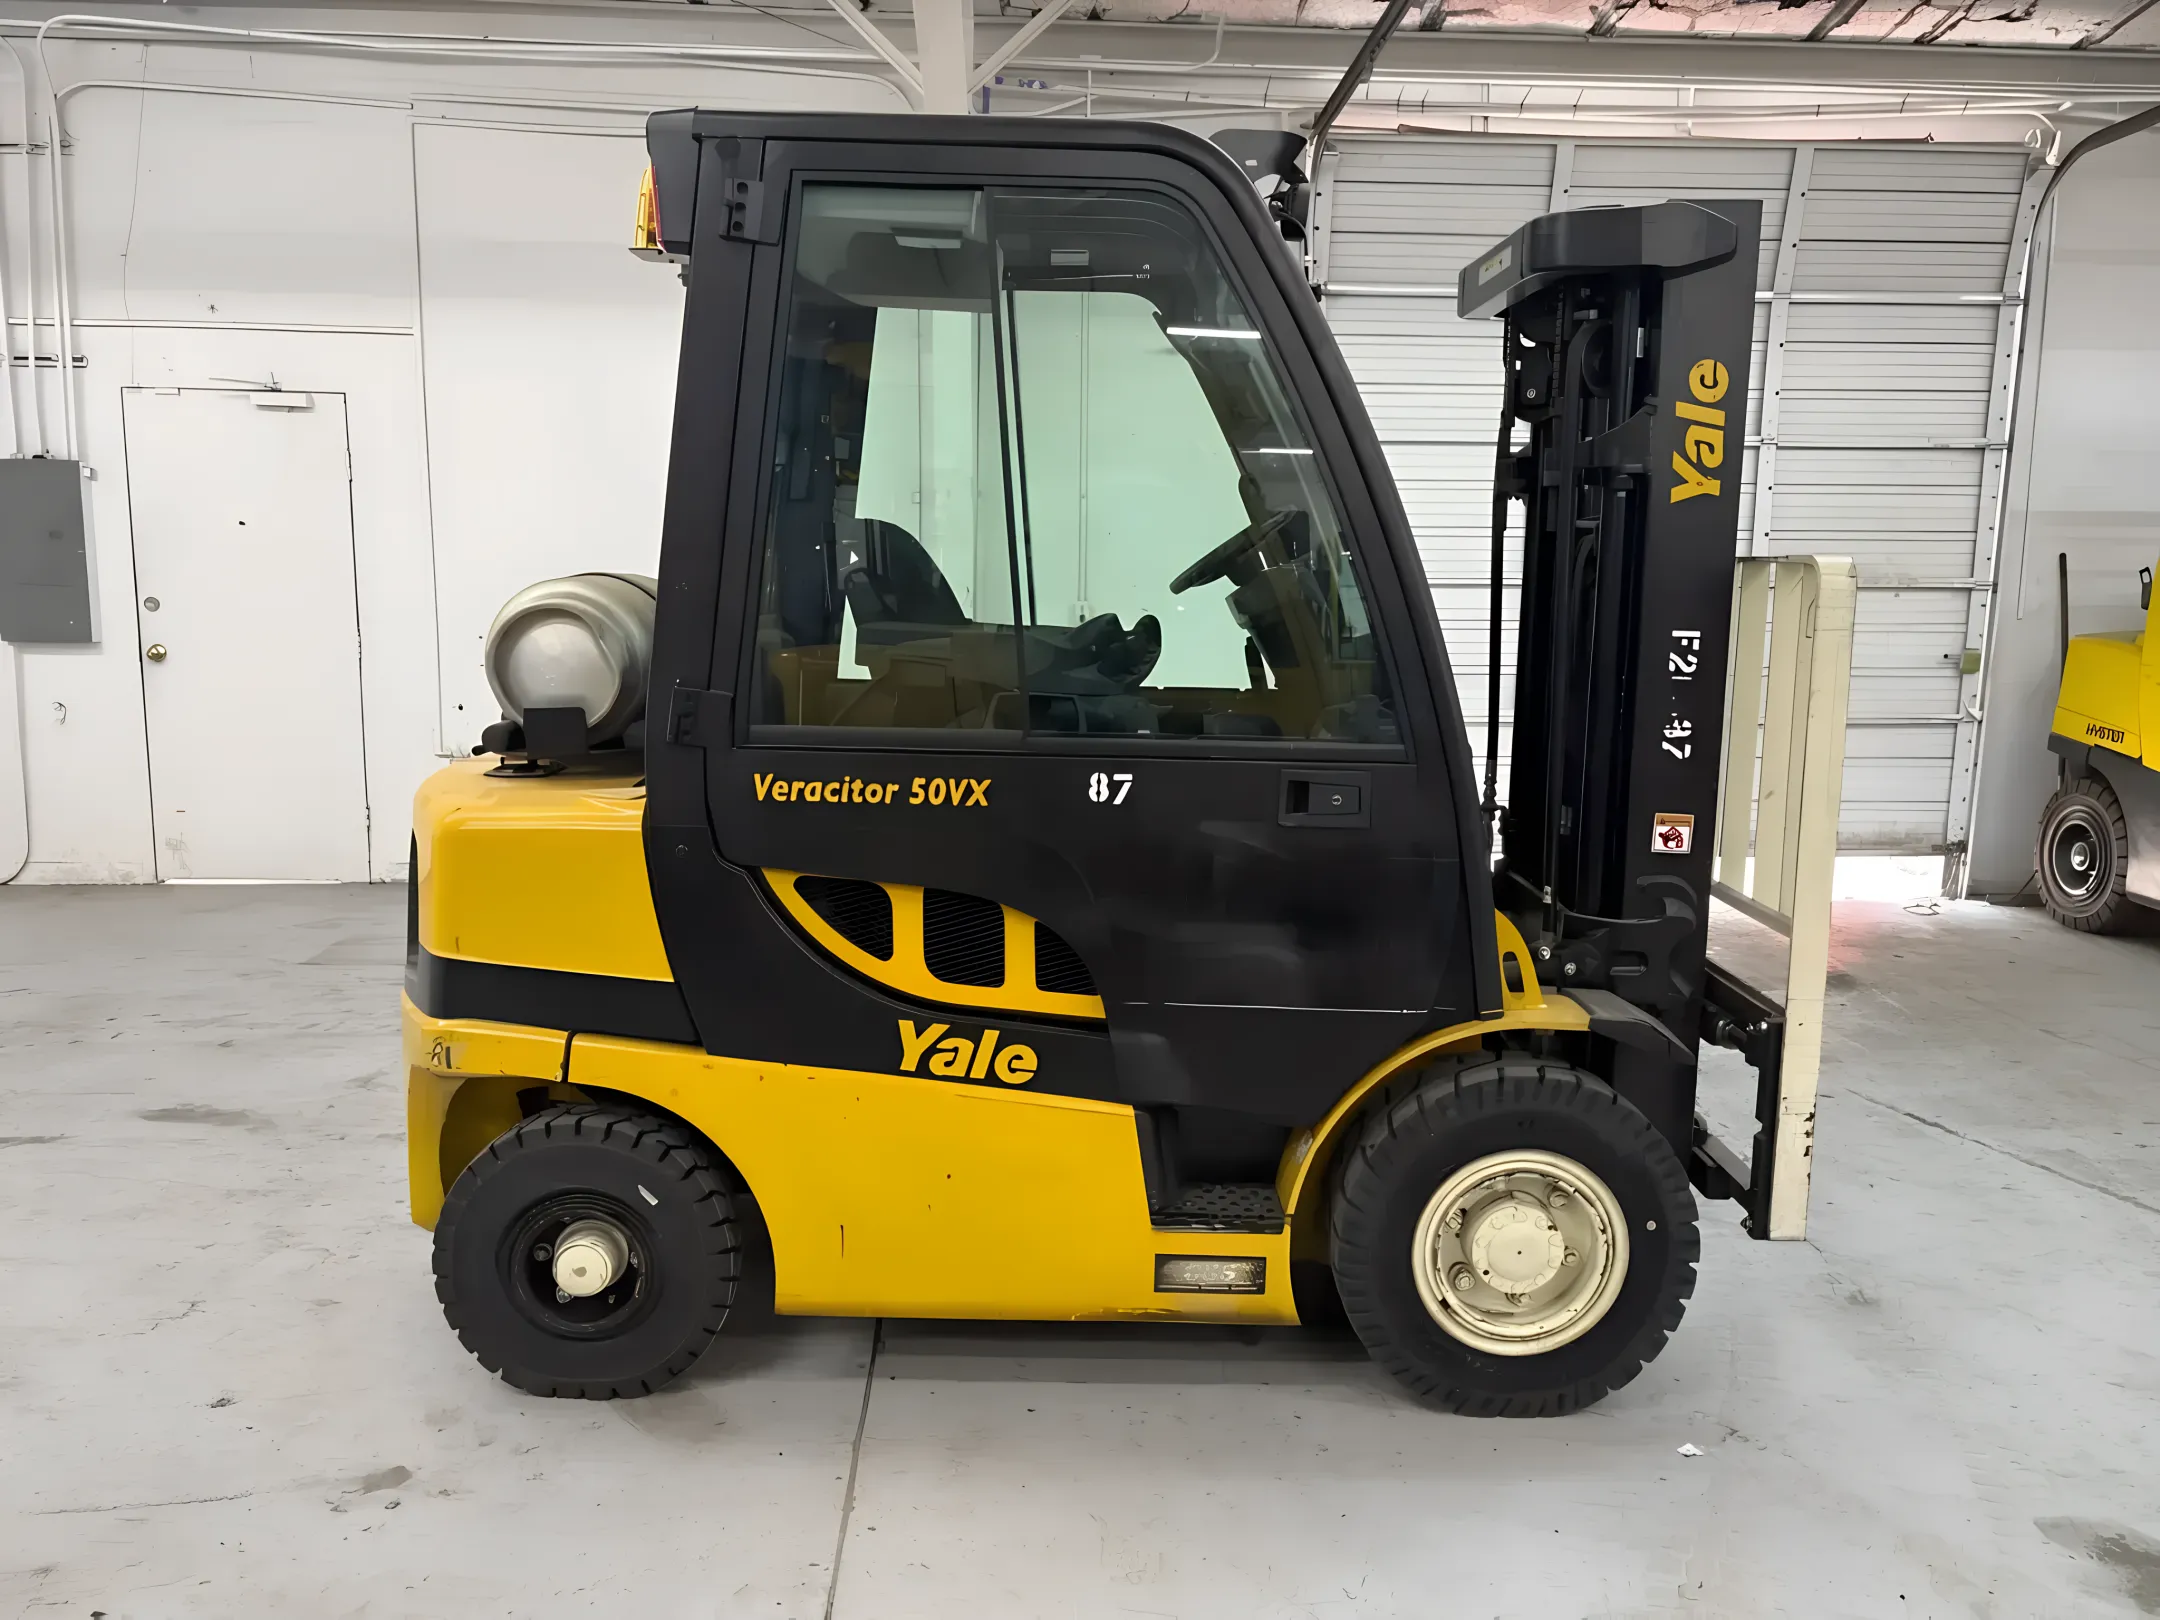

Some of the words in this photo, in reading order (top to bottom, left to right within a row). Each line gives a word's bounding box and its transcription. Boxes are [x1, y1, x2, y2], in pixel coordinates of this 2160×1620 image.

[1670, 359, 1729, 503] Yale
[753, 773, 900, 804] Veracitor
[909, 777, 992, 806] 50VX
[1088, 772, 1133, 805] 87
[898, 1019, 1038, 1084] Yale
